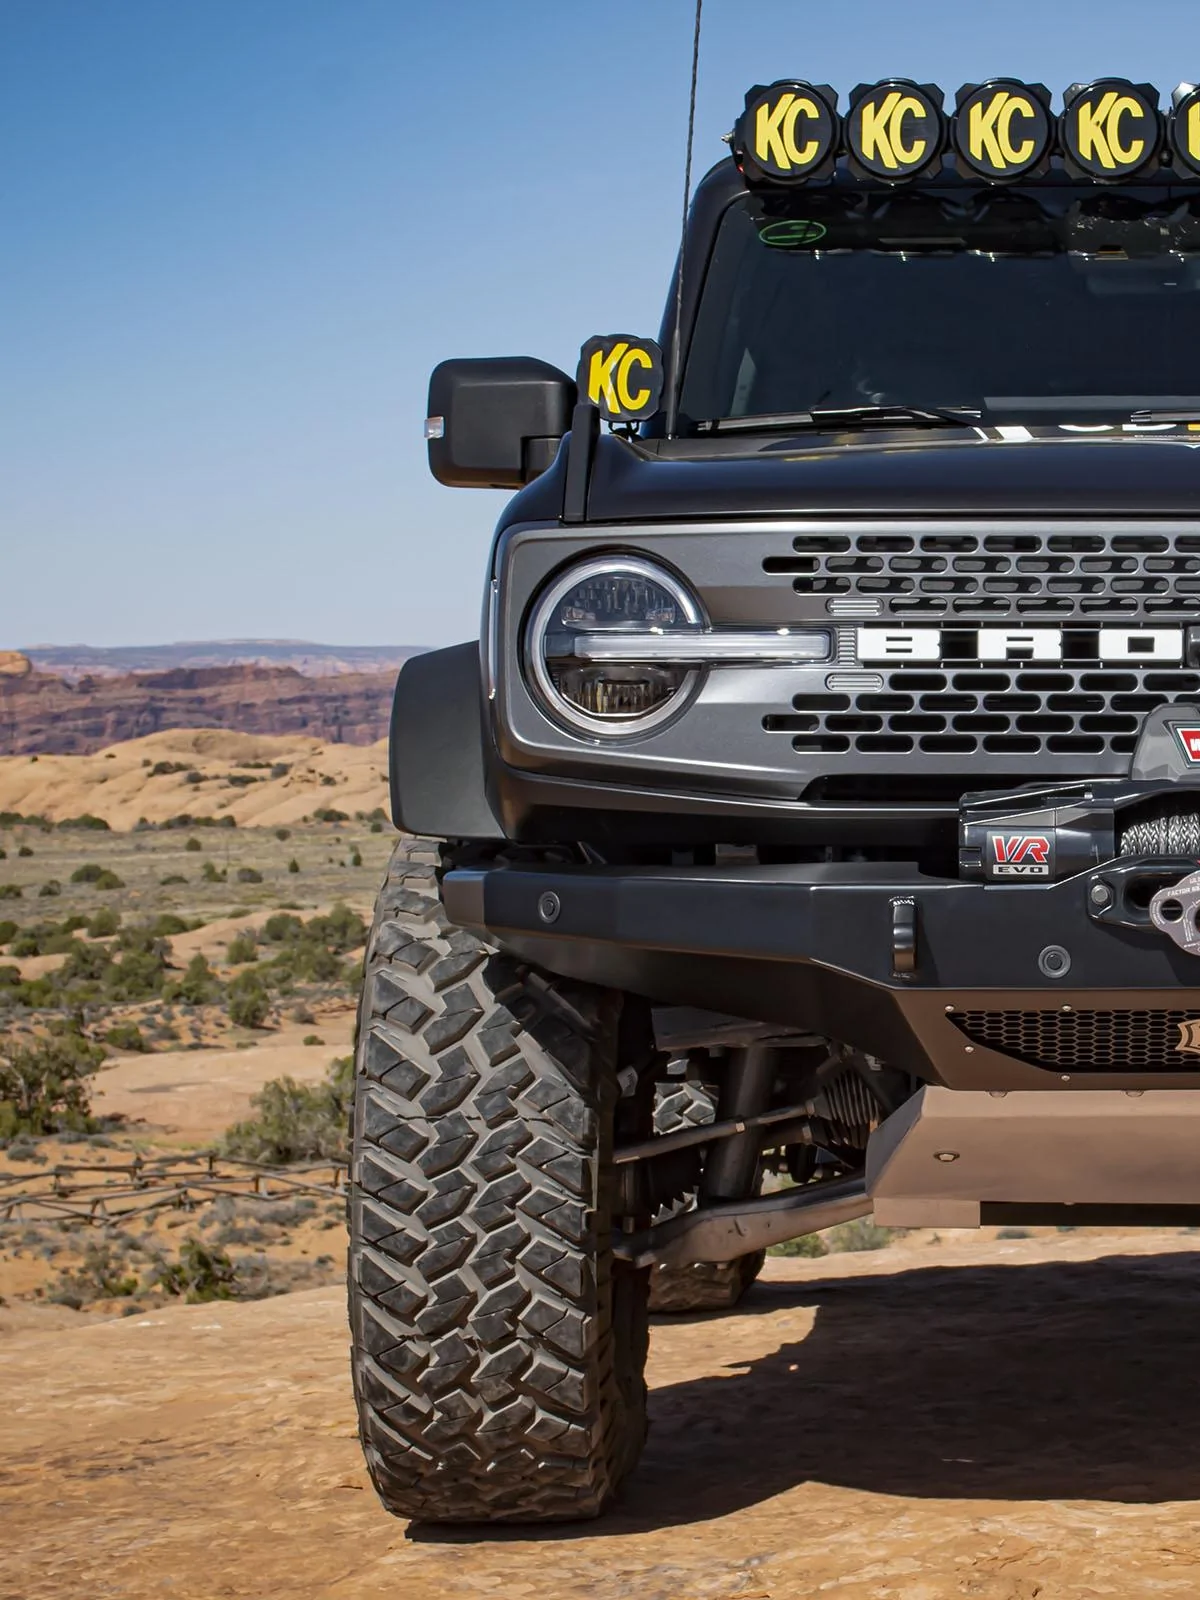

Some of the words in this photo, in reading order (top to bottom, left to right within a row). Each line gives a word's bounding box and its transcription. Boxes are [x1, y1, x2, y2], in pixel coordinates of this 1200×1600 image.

[755, 93, 820, 170] KC
[861, 92, 927, 169] KC
[969, 91, 1035, 169] KC
[1078, 91, 1144, 169] KC
[587, 342, 653, 414] KC
[992, 836, 1050, 863] VR
